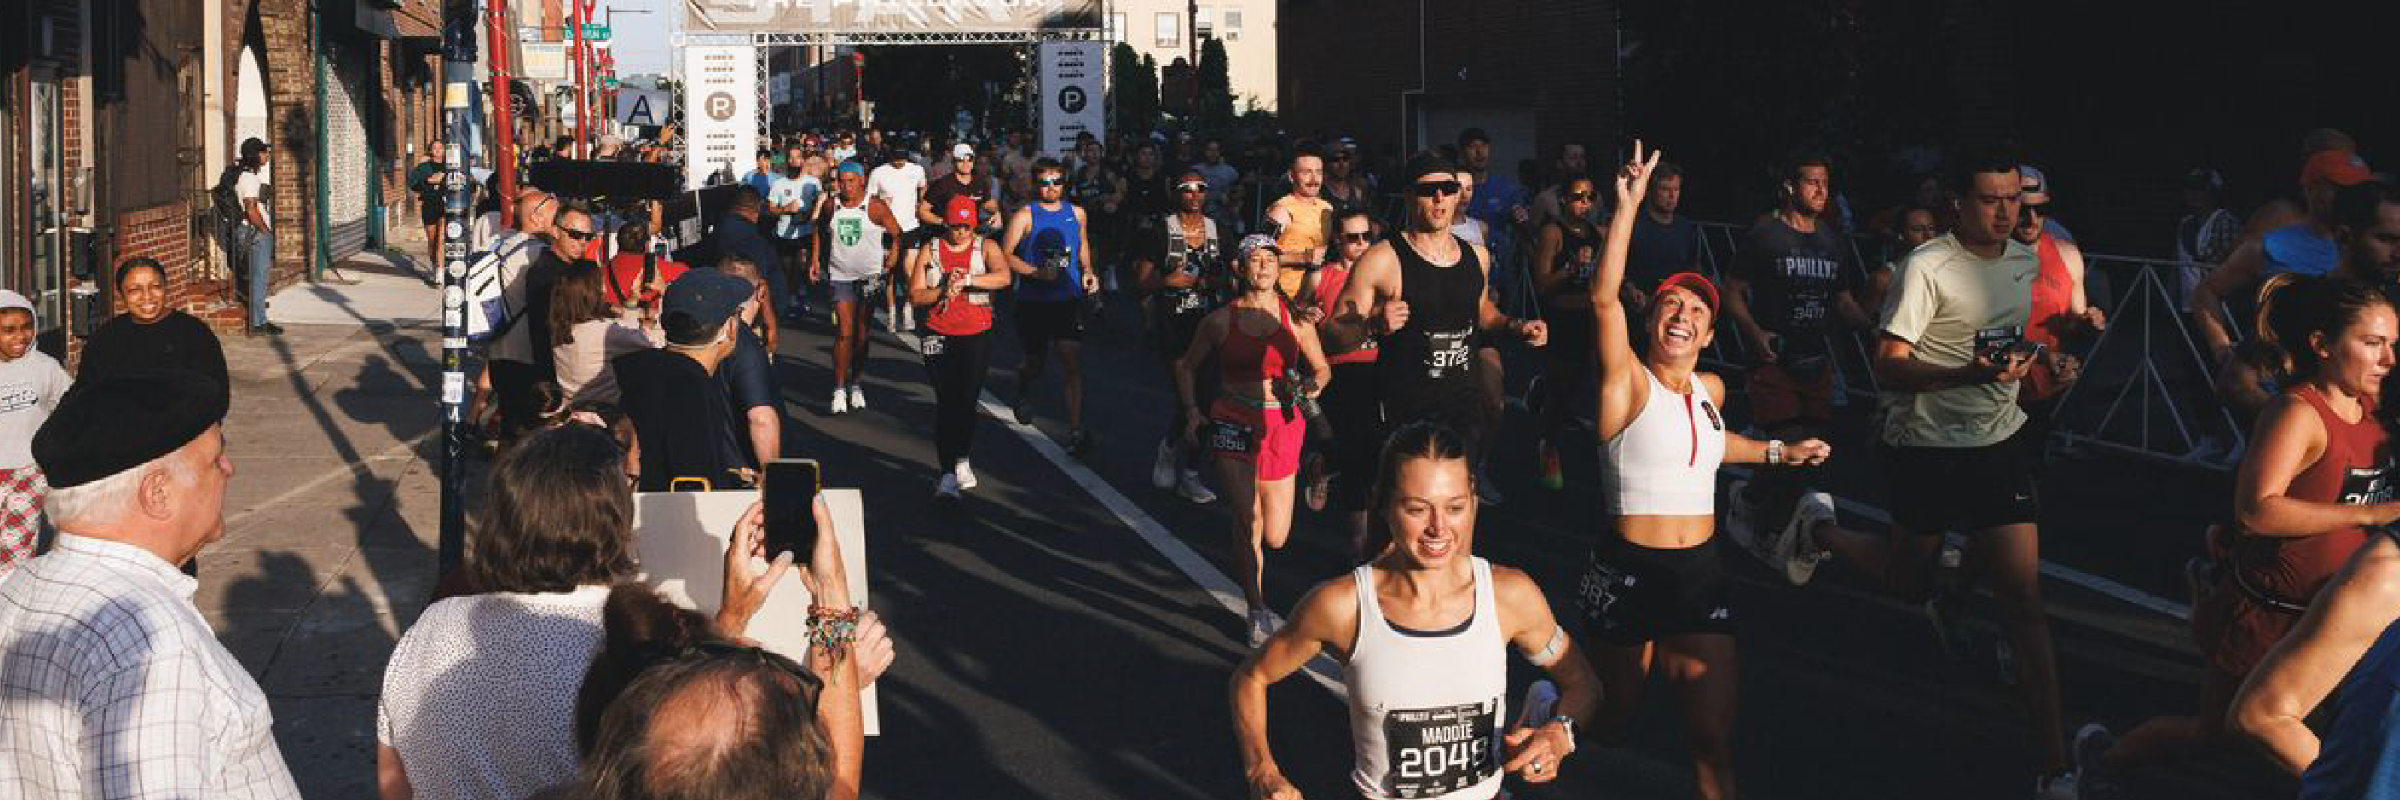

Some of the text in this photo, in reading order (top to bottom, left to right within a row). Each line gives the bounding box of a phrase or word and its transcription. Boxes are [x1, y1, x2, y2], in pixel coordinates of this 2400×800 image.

[627, 94, 653, 124] A
[1785, 256, 1831, 279] PHILLY
[1421, 722, 1473, 745] MADDIE
